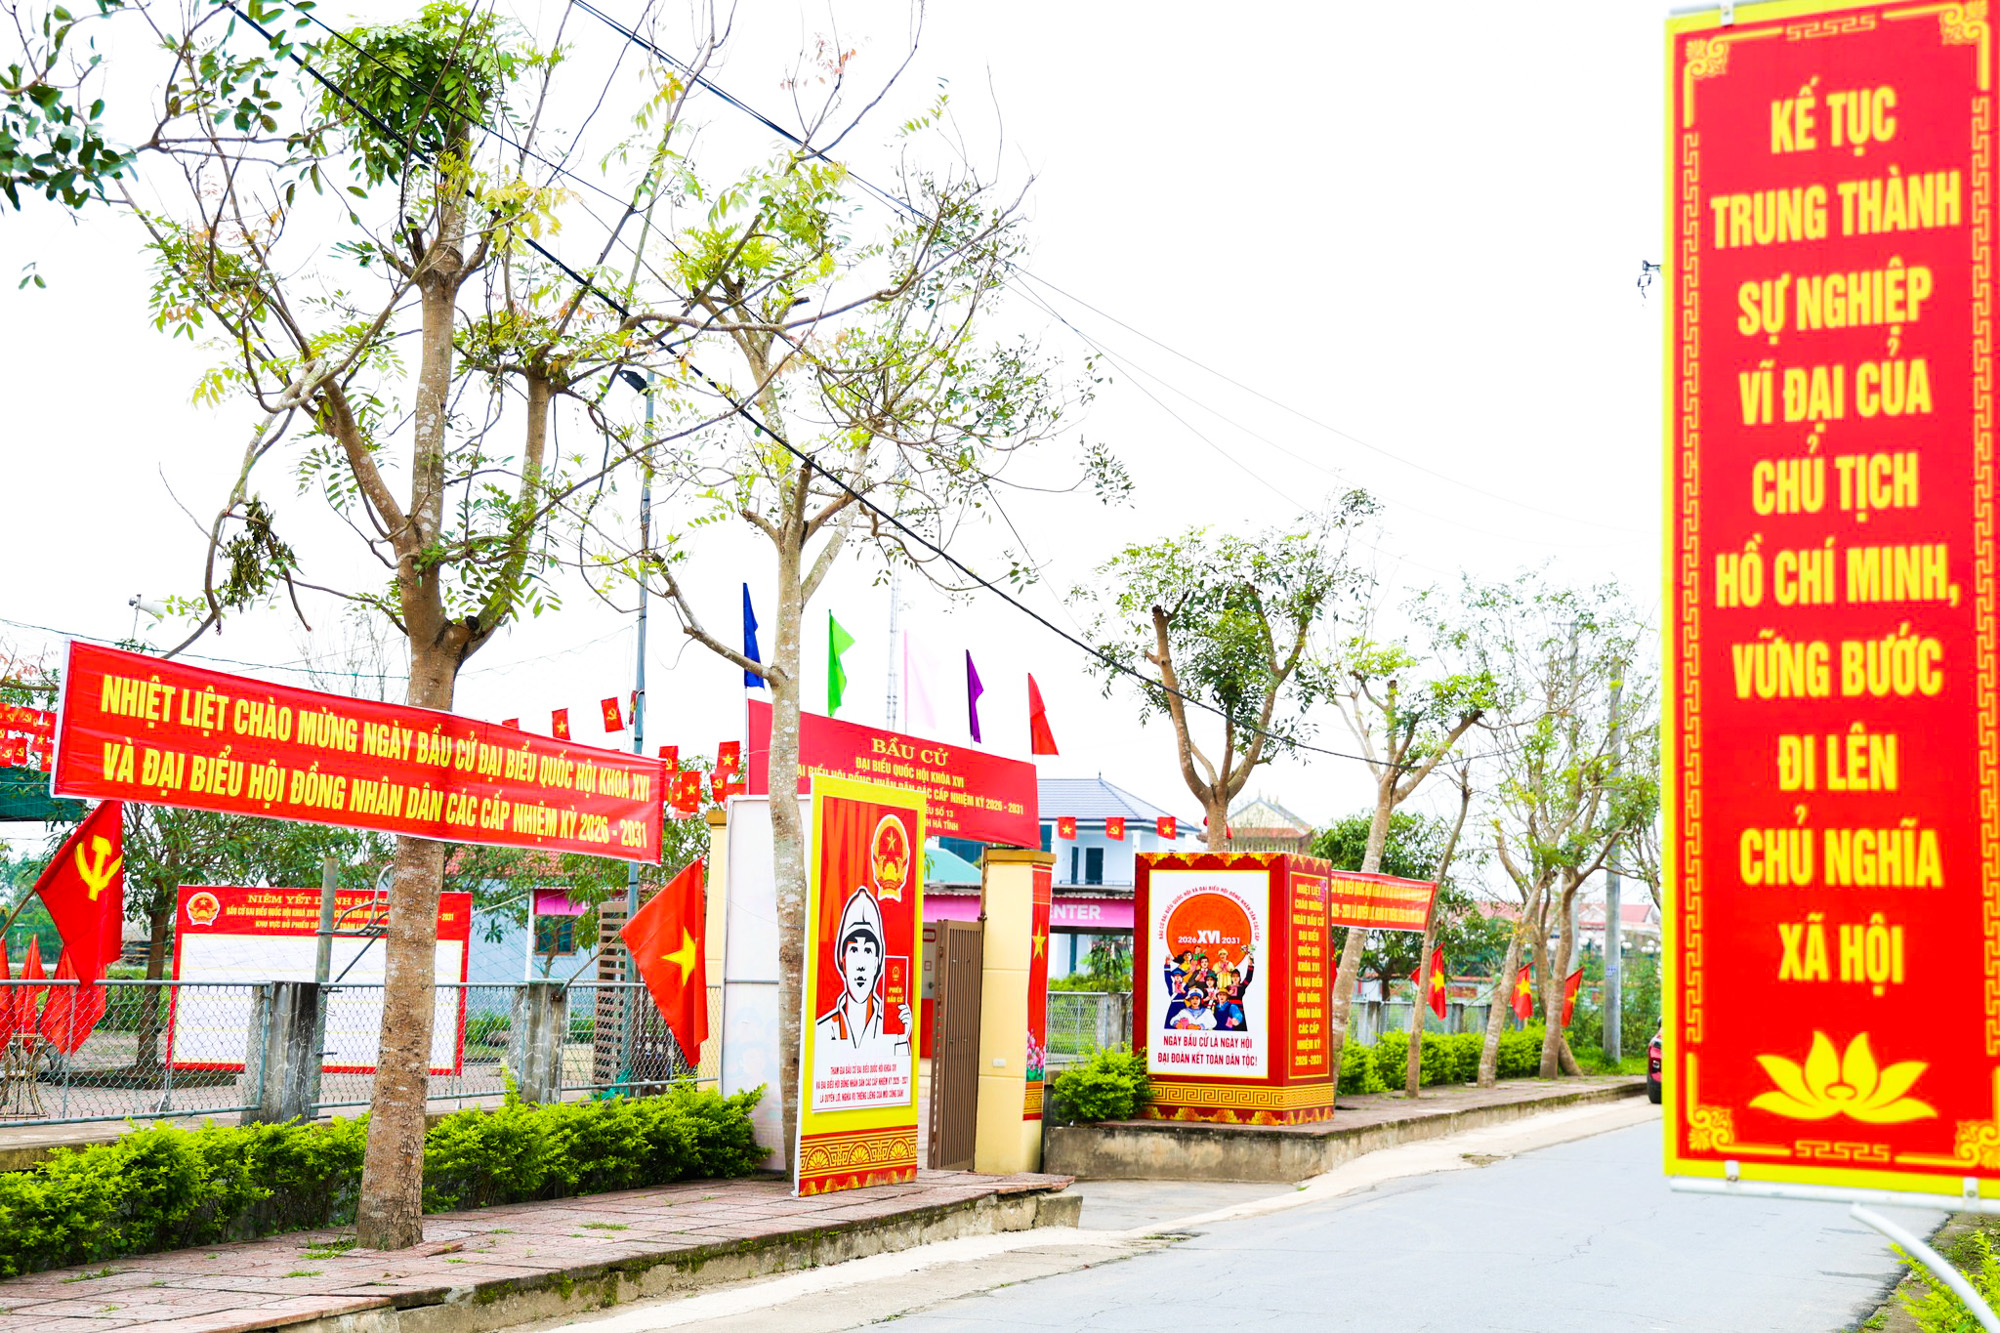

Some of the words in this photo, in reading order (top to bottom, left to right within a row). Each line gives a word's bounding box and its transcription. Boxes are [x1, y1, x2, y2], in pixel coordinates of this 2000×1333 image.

[1770, 75, 1820, 154] KẾ
[1825, 86, 1897, 156] TỤC
[1710, 185, 1828, 249] TRUNG
[1837, 164, 1961, 236] THÀNH
[1737, 272, 1791, 345] SỰ
[1796, 255, 1932, 336] NGHIỆP
[1738, 359, 1775, 426] VĨ
[1782, 364, 1844, 433] ĐẠI
[1855, 335, 1932, 418] CỦA
[1752, 434, 1825, 516] CHỦ
[1834, 452, 1919, 523] TỊCH
[1715, 533, 1763, 608] HỒ
[1774, 535, 1835, 606] CHÍ
[1846, 544, 1960, 608] MINH,
[1732, 628, 1830, 699] VỮNG
[1841, 621, 1943, 697] BƯỚC
[101, 674, 176, 729] NHIỆT
[180, 685, 229, 737] LIỆT
[234, 696, 292, 742] CHÀO
[297, 706, 358, 753] MỪNG
[362, 720, 413, 761] NGÀY
[416, 723, 452, 768] BẦU
[455, 730, 478, 772] CỬ
[477, 743, 503, 782] ĐẠI
[505, 740, 537, 782] BIỂU
[539, 750, 573, 788] QUỐC
[575, 758, 596, 799] HỘI
[599, 766, 630, 799] KHOÁ
[631, 773, 650, 802] XVI
[856, 756, 870, 772] ĐẠI
[872, 757, 891, 774] BIỂU
[893, 762, 915, 779] QUỐC
[916, 768, 929, 784] HỘI
[952, 775, 964, 788] XVI
[871, 737, 915, 760] BẦU
[921, 748, 948, 766] CỬ
[1777, 733, 1815, 791] ĐI
[1826, 721, 1897, 791] LÊN
[103, 737, 134, 784] VÀ
[141, 748, 185, 797] ĐẠI
[189, 744, 244, 797] BIỂU
[247, 759, 286, 809] HỘI
[290, 761, 346, 810] ĐỒNG
[349, 775, 404, 817] NHÂN
[405, 782, 444, 822] DÂN
[445, 788, 478, 827] CÁC
[480, 789, 510, 831] CẤP
[513, 800, 557, 843] NHIỆM
[559, 805, 577, 840] KỲ
[578, 813, 609, 844] 2026
[619, 818, 648, 849] 2031
[797, 763, 805, 779] ẠI
[934, 787, 949, 802] CẤP
[951, 792, 973, 807] NHIỆM
[986, 799, 1003, 811] 2026
[1008, 802, 1024, 815] 2031
[935, 805, 944, 816] SỐ
[946, 810, 954, 818] 13
[1739, 804, 1814, 886] CHỦ
[1824, 818, 1944, 888] NGHĨA
[1178, 936, 1197, 944] 2026
[1196, 930, 1221, 944] XVI
[1221, 936, 1240, 944] 2031
[1777, 912, 1830, 982] XÃ
[1839, 912, 1904, 998] HỘI
